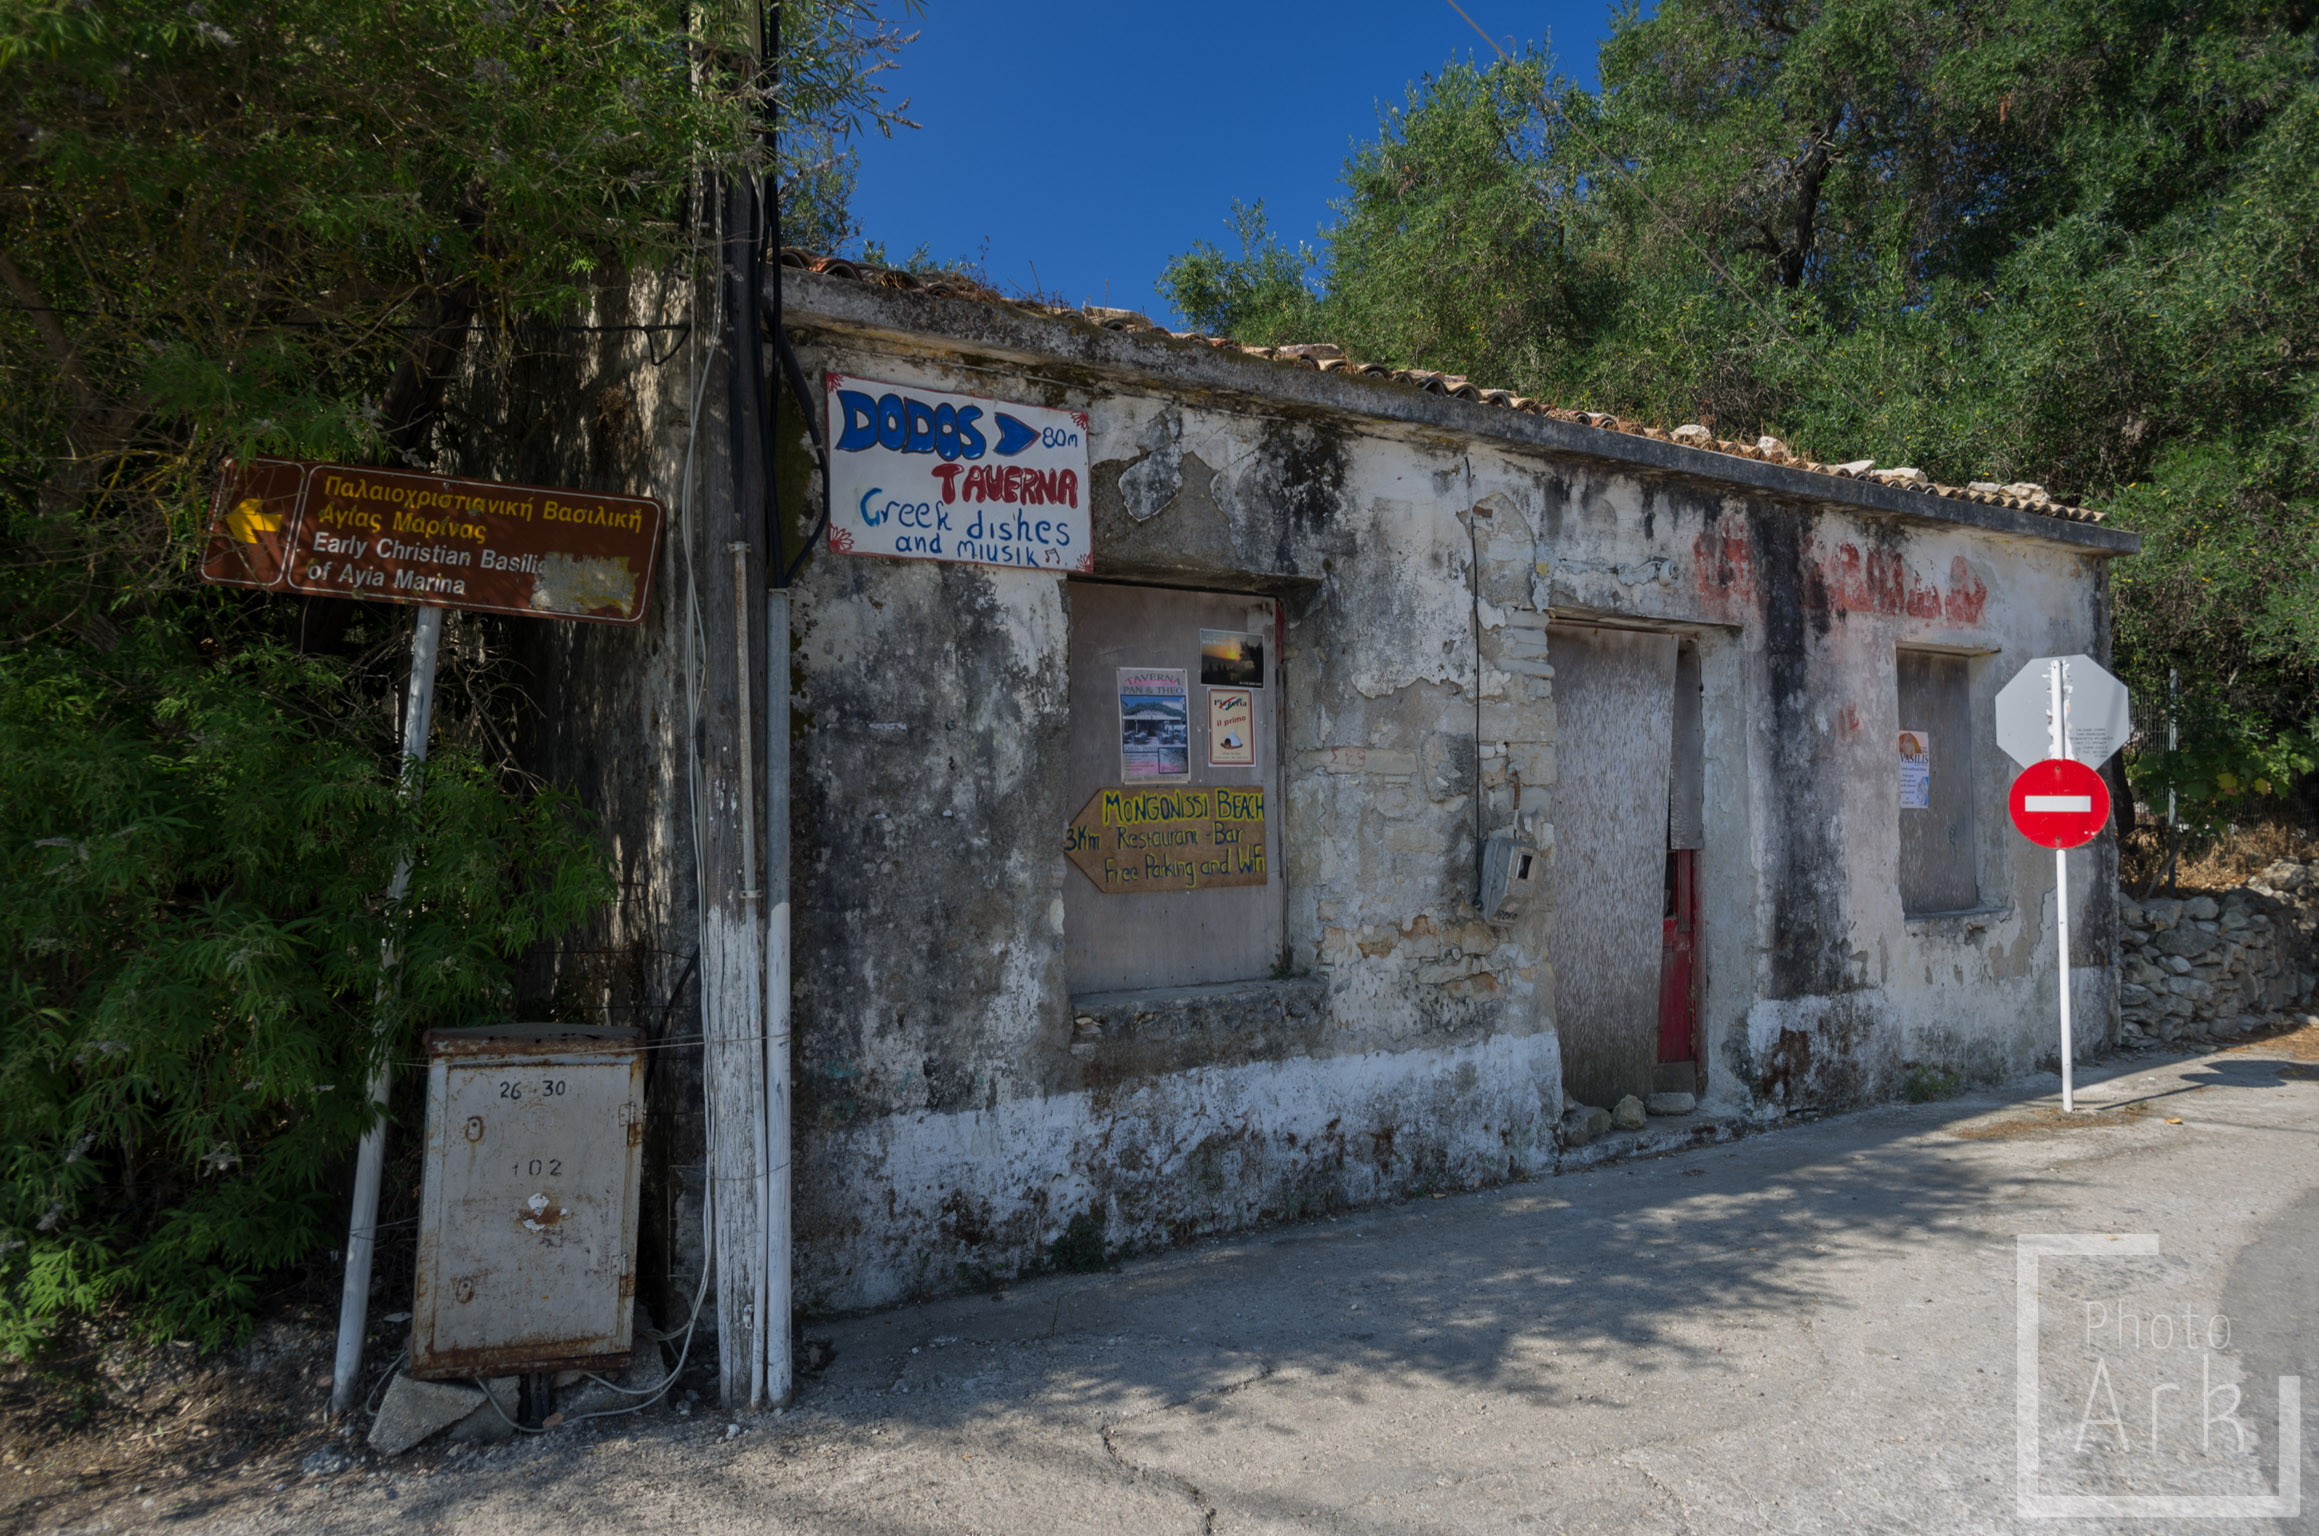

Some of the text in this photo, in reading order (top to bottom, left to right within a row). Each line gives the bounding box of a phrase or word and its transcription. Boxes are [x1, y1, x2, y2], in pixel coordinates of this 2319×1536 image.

[835, 390, 987, 461] DODOS
[1042, 427, 1078, 448] 80m
[931, 463, 1078, 509] TAVERNA
[324, 476, 643, 533] Παλαιοχριστιανική Βασιλική
[860, 487, 1070, 546] Greek dishes
[319, 502, 487, 544] Αγίας Μαρίνας
[313, 532, 368, 560] Early
[376, 537, 471, 567] Christian
[896, 533, 942, 553] and
[307, 563, 467, 596] of Ayia Marina
[1123, 686, 1184, 695] PAN & THEO
[1125, 673, 1181, 686] TAVERNA
[1224, 715, 1247, 728] primo
[1899, 752, 1929, 764] VASILIS
[1103, 787, 1264, 825] MONGONISSI BEACH
[1104, 857, 1138, 883] Free
[1144, 852, 1196, 888] Parking
[1200, 846, 1231, 876] and
[500, 1080, 566, 1100] 26 30
